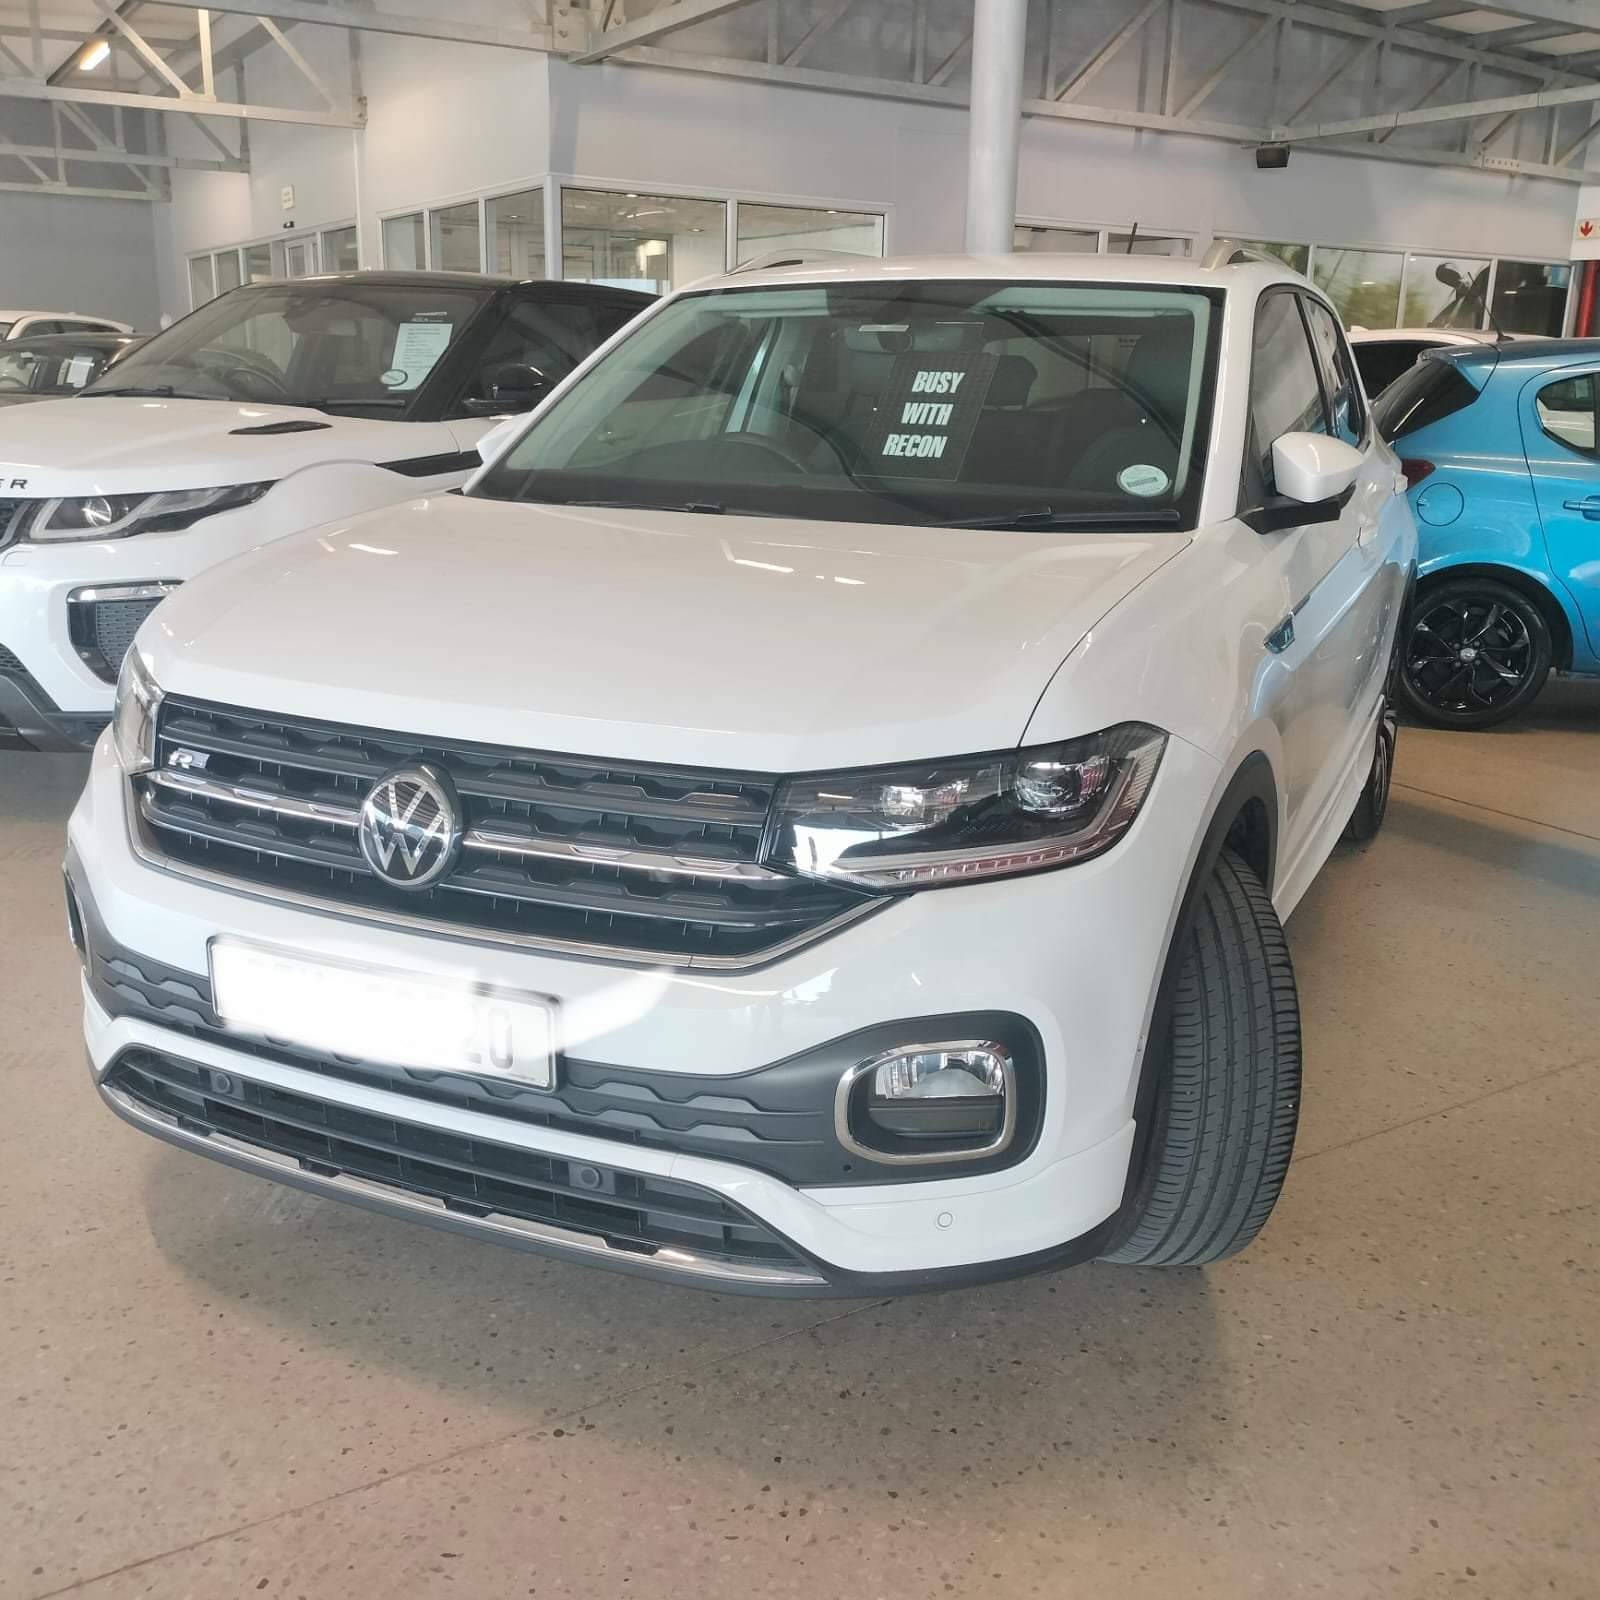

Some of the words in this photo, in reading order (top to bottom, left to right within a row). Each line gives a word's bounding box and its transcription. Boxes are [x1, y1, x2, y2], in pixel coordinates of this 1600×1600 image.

[911, 370, 966, 394] BUSY
[901, 402, 954, 426] WITH
[881, 433, 948, 458] RECON
